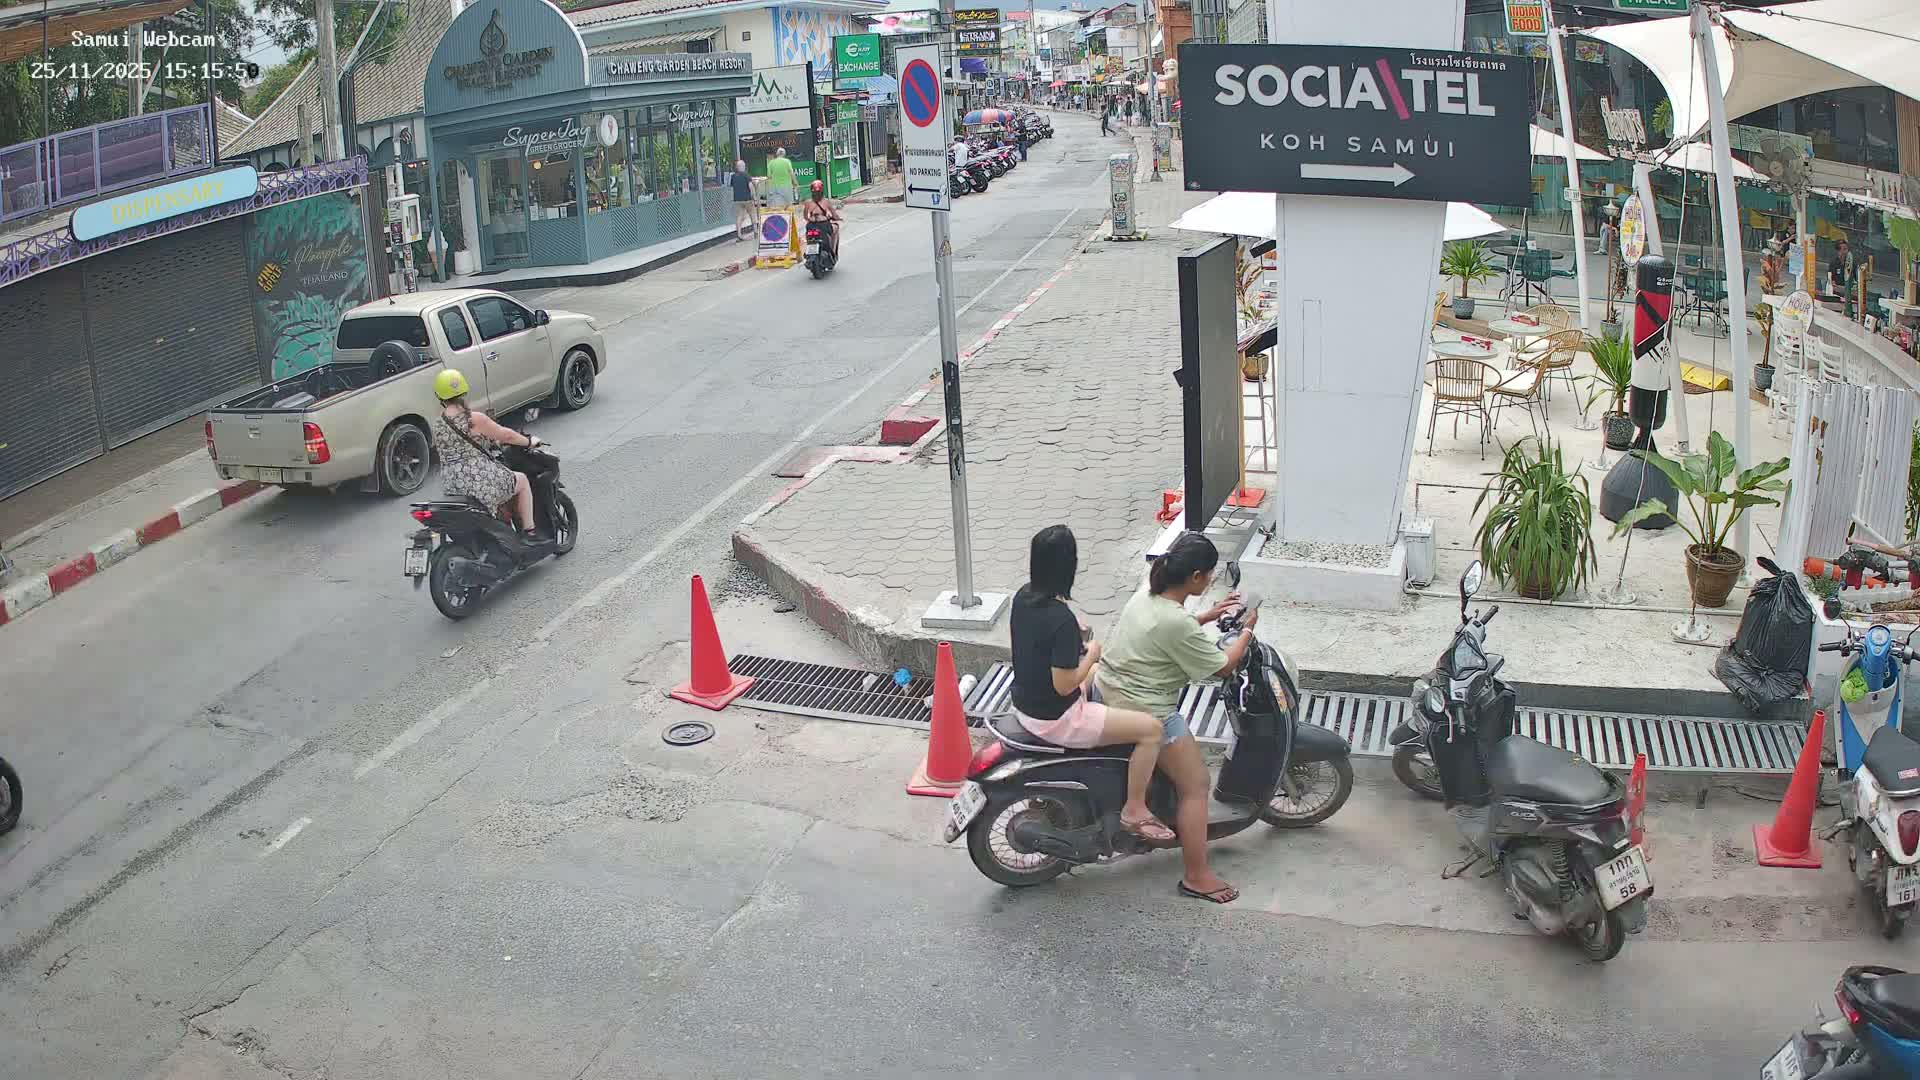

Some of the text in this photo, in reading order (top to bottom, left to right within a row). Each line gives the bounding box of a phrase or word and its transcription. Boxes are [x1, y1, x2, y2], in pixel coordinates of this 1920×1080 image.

[1509, 5, 1542, 17] INDIAN
[1512, 18, 1542, 31] FOOD
[611, 58, 746, 75] CHAWENG GARDEN BEACH RESORT
[839, 61, 879, 73] EXCHANGE
[1410, 53, 1506, 71] โรงแรมโซเชียลเทล
[740, 94, 799, 105] CHAWENG
[1260, 133, 1455, 158] KOH SAMUI
[795, 167, 813, 176] ANGE
[910, 167, 941, 176] NO PARKING
[112, 179, 225, 225] DISPENSARY
[303, 271, 348, 286] THAILAND
[1620, 883, 1637, 898] 58
